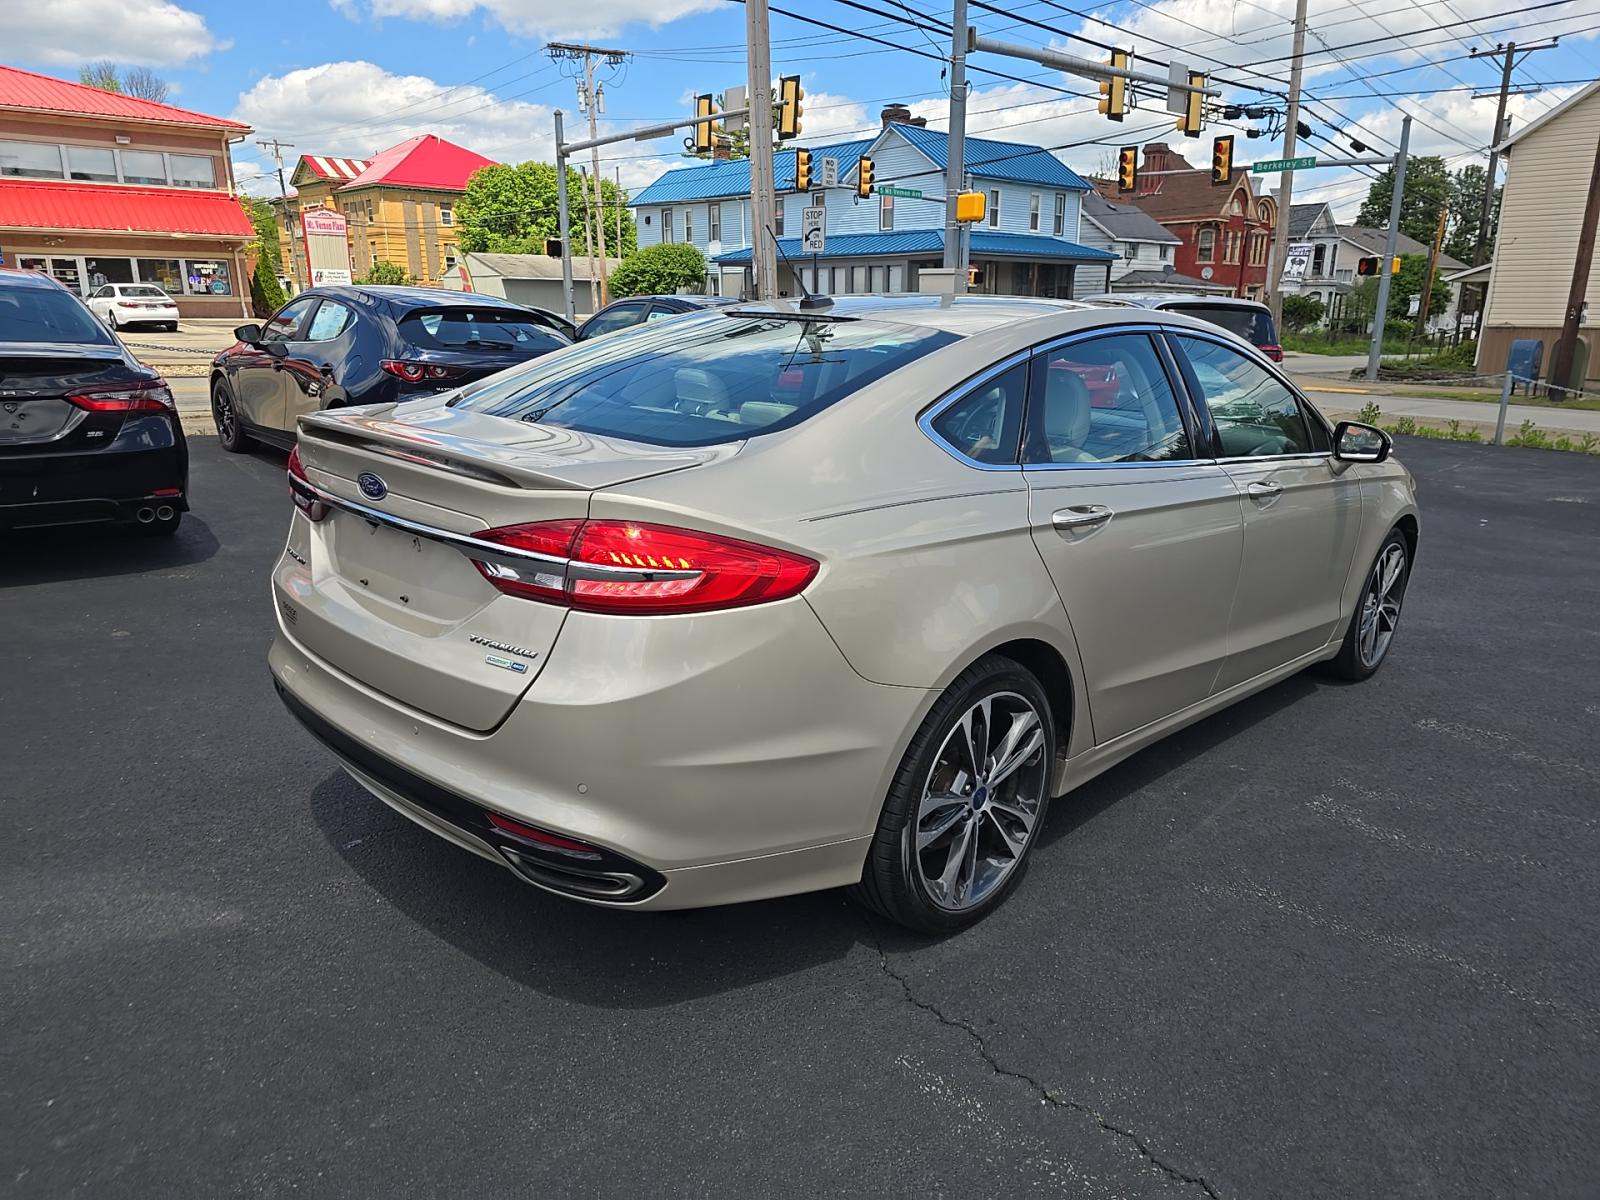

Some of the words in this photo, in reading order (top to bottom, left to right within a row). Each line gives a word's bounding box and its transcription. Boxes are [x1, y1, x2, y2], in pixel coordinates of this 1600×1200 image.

[1257, 160, 1297, 170] Berkeley
[1302, 158, 1312, 167] St
[805, 210, 823, 220] STOP
[332, 220, 345, 231] Plaza
[810, 241, 823, 249] RED
[189, 276, 212, 286] OPEN
[469, 633, 538, 659] TITANIUM
